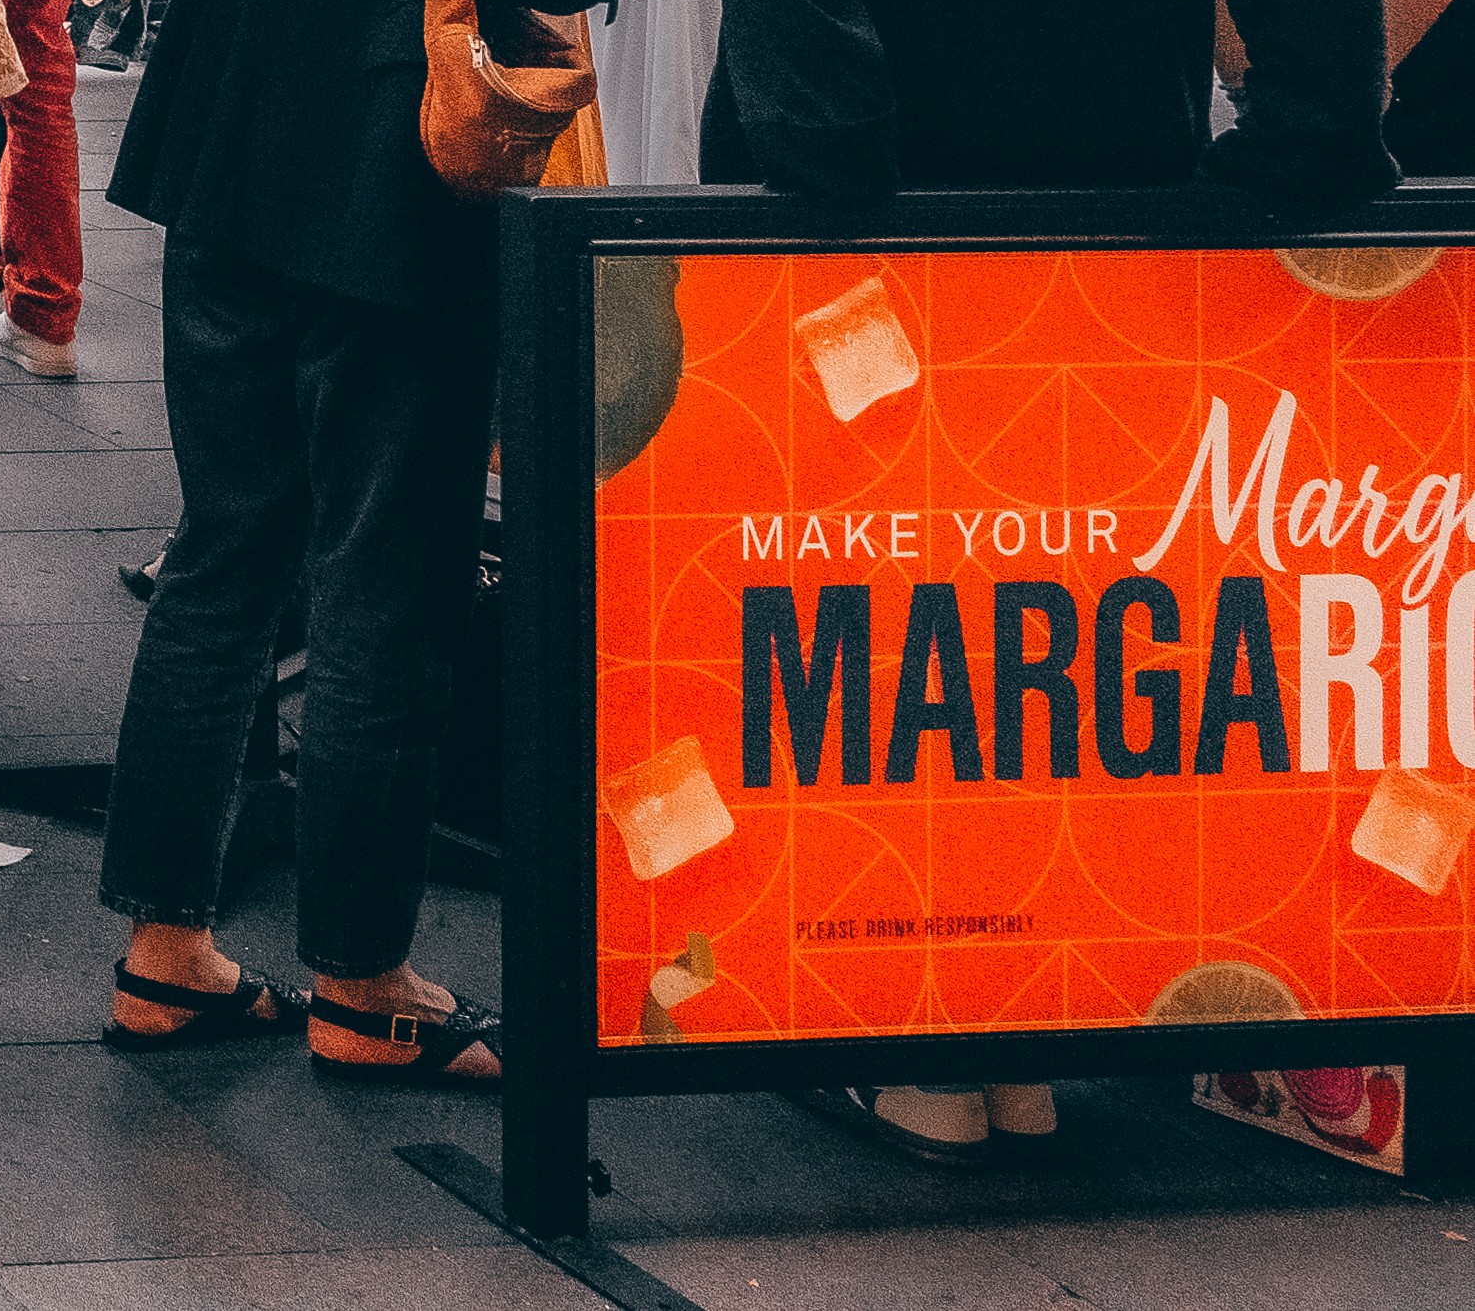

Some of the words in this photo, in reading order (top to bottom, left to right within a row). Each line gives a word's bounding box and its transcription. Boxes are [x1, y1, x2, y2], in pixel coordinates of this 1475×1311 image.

[742, 512, 920, 561] MAKE
[952, 509, 1120, 556] YOUR
[1132, 389, 1475, 605] Marg
[796, 918, 856, 940] PLEASE
[866, 918, 918, 938] DRINK
[925, 914, 1034, 938] RESPONSIBLY
